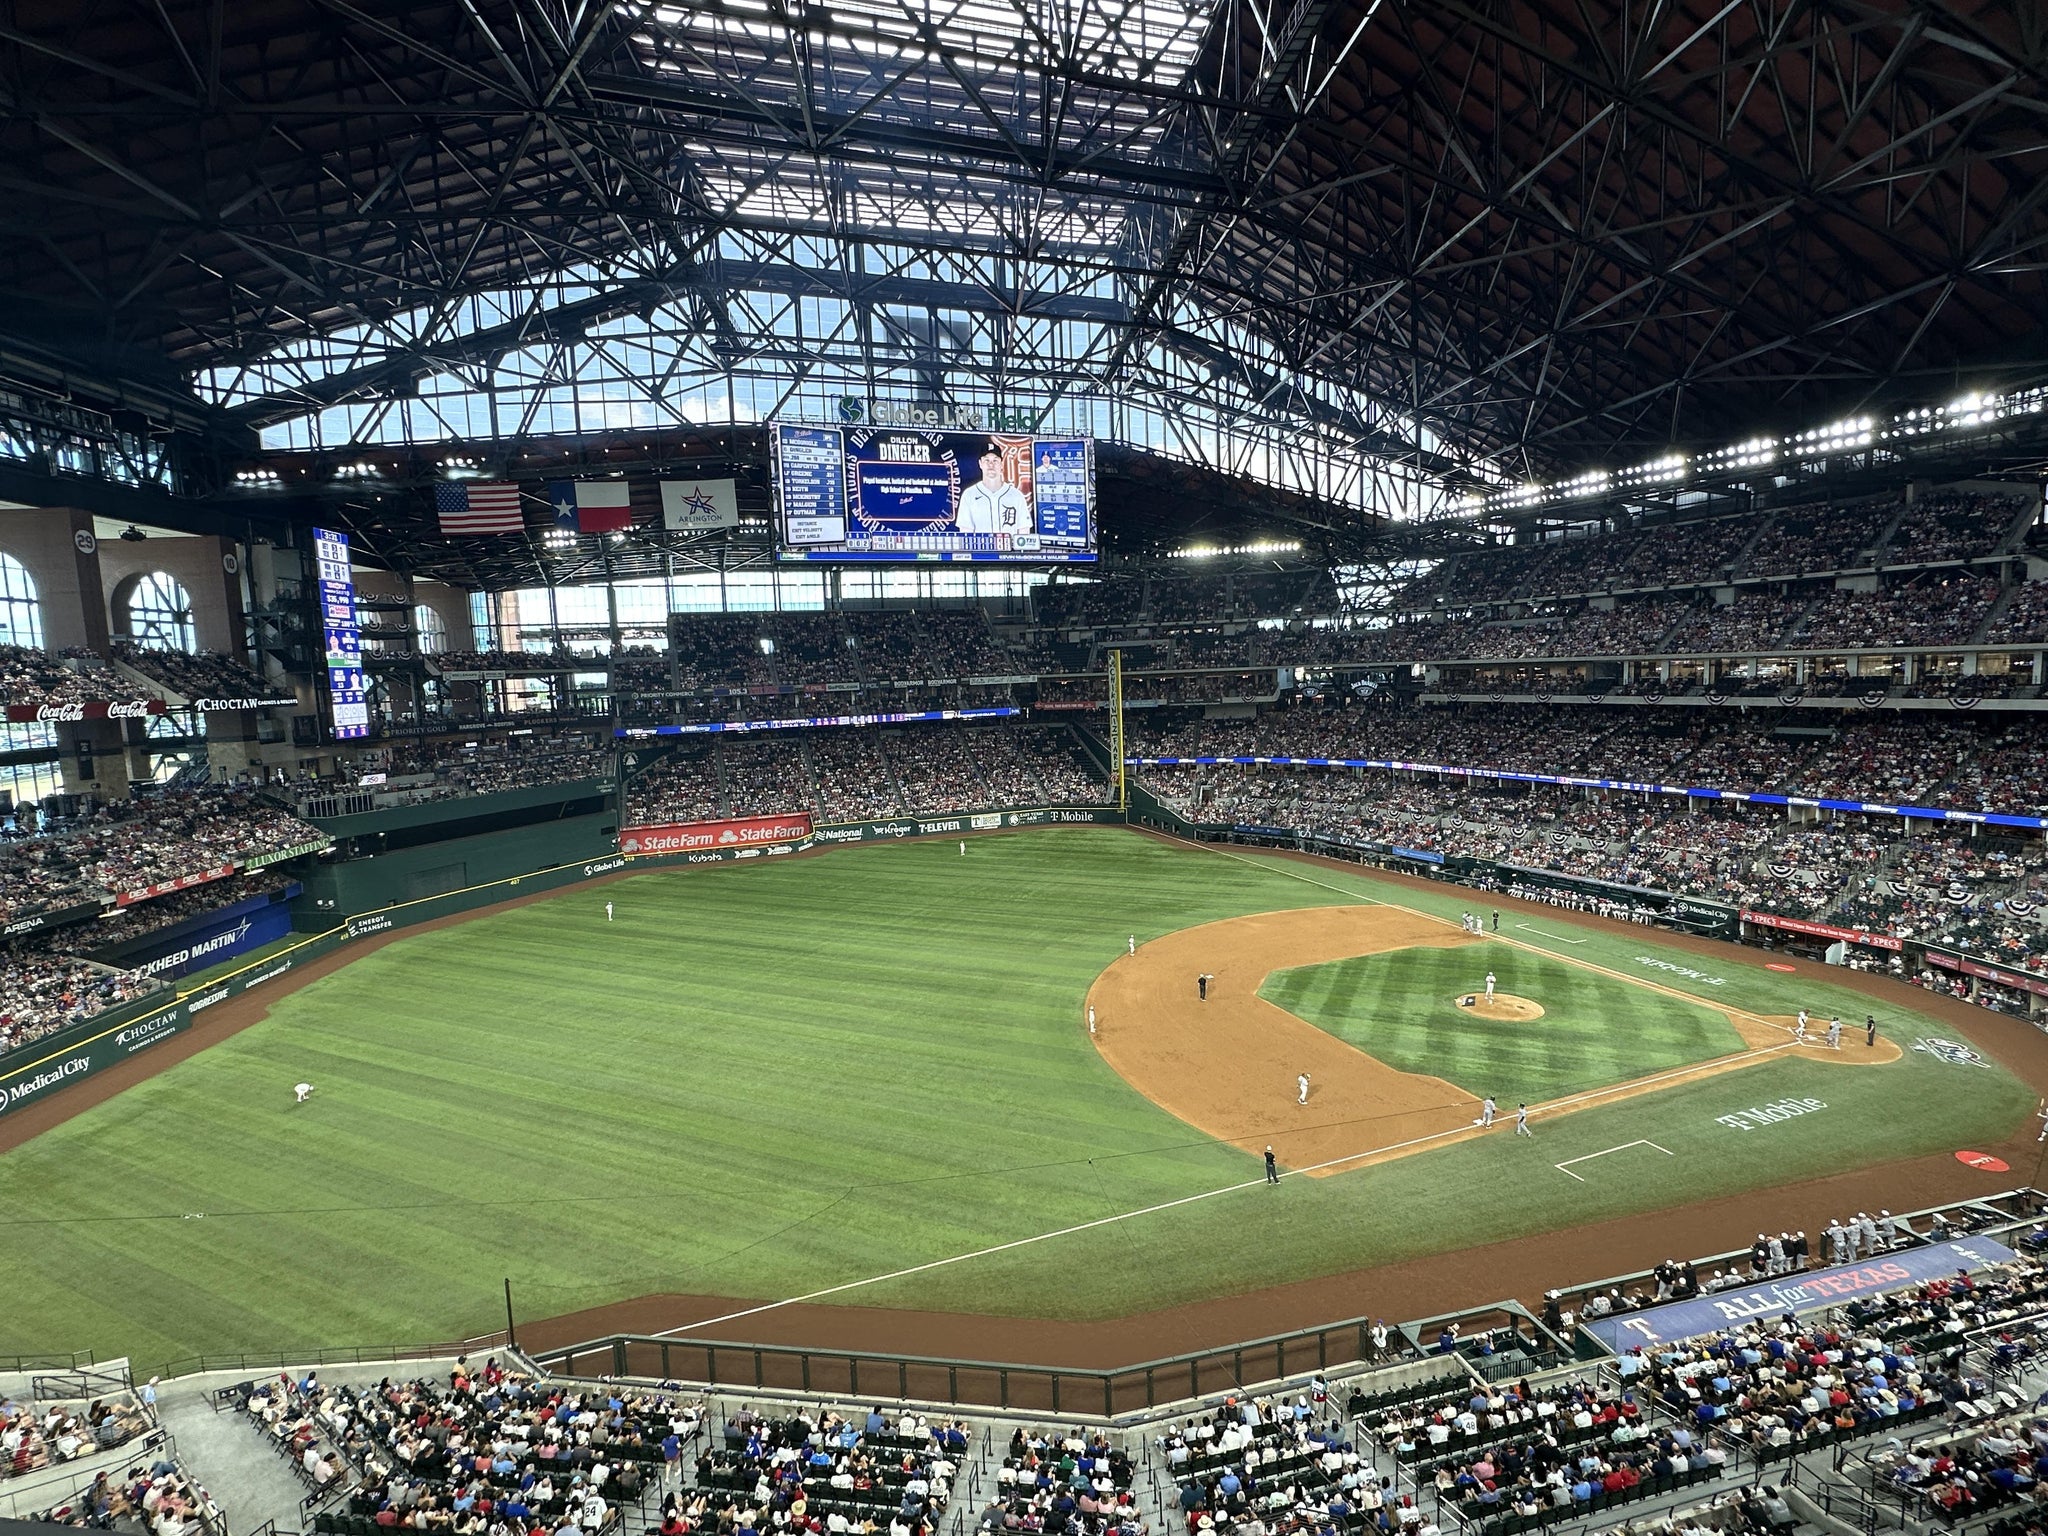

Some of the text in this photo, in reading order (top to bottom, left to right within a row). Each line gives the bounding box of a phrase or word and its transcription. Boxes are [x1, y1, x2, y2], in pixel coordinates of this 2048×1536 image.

[871, 401, 1036, 430] Globe Life Field
[879, 444, 930, 462] DINGLER
[679, 514, 722, 524] ARLINGTON
[78, 534, 92, 548] 29
[226, 558, 234, 568] 10
[729, 688, 748, 696] 105.3
[1109, 668, 1117, 714] CHIKIN
[108, 702, 149, 718] Coca-Cola
[202, 699, 258, 710] CHOCTAW
[37, 703, 86, 722] Coca-Cola
[391, 725, 448, 734] PRIORITY GOLD
[1061, 811, 1094, 822] Mobile
[1952, 812, 1986, 821] TXUenergy
[826, 828, 863, 840] National
[884, 822, 912, 838] Kroger
[254, 838, 329, 868] LUXOR STAFFING
[689, 853, 723, 863] Kubota
[206, 867, 224, 878] DEX
[594, 859, 625, 873] Globe Life
[156, 880, 176, 891] DEX
[182, 874, 200, 884] DEX
[128, 888, 148, 899] DEX
[1689, 905, 1730, 921] Medical City
[4, 918, 44, 934] ARENA
[358, 916, 385, 927] ENERGY
[359, 921, 392, 934] TRANSFER
[1754, 915, 1776, 926] SPEC'S
[1873, 937, 1900, 949] SPEC'S
[192, 932, 236, 958] MARTIN
[1634, 956, 1707, 979] Mobile
[246, 966, 286, 988] LOCKHEED MARTIN
[121, 1011, 178, 1044] CHOCTAW
[128, 1038, 150, 1052] CASINOS
[154, 1027, 176, 1042] RESORTS
[10, 1056, 91, 1102] Medical City
[1736, 1098, 1828, 1126] Mobile
[1714, 1263, 1910, 1320] ALL for TEXAS
[1622, 1317, 1661, 1340] T
[1466, 1422, 1476, 1430] 48
[1373, 1496, 1378, 1506] 8
[586, 1506, 596, 1518] 24
